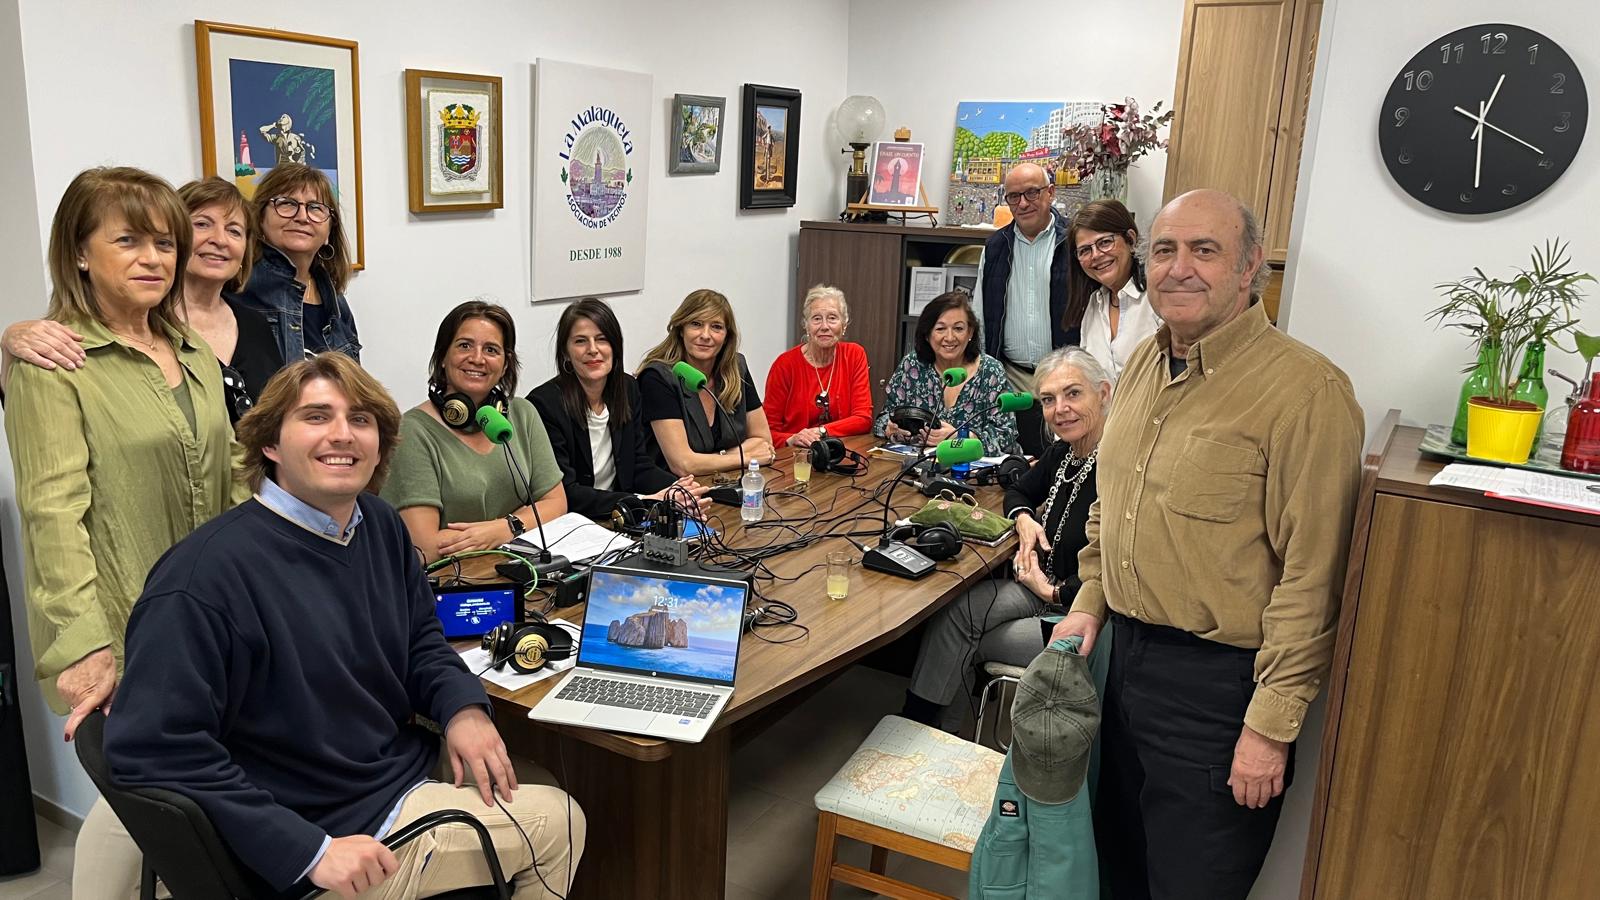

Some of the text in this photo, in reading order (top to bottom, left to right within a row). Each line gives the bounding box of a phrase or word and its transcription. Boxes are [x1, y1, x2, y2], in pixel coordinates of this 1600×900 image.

[1440, 42, 1464, 64] 11
[1480, 32, 1508, 54] 12
[1527, 43, 1539, 65] 1
[1404, 70, 1434, 91] 10
[1550, 73, 1566, 94] 2
[1394, 106, 1410, 127] 9
[1553, 111, 1571, 132] 3
[559, 105, 633, 160] La Malagueta
[566, 193, 627, 229] ASOCIACIÓN DE VECINOS
[569, 246, 622, 261] DESDE 1988
[653, 595, 679, 608] 12:31
